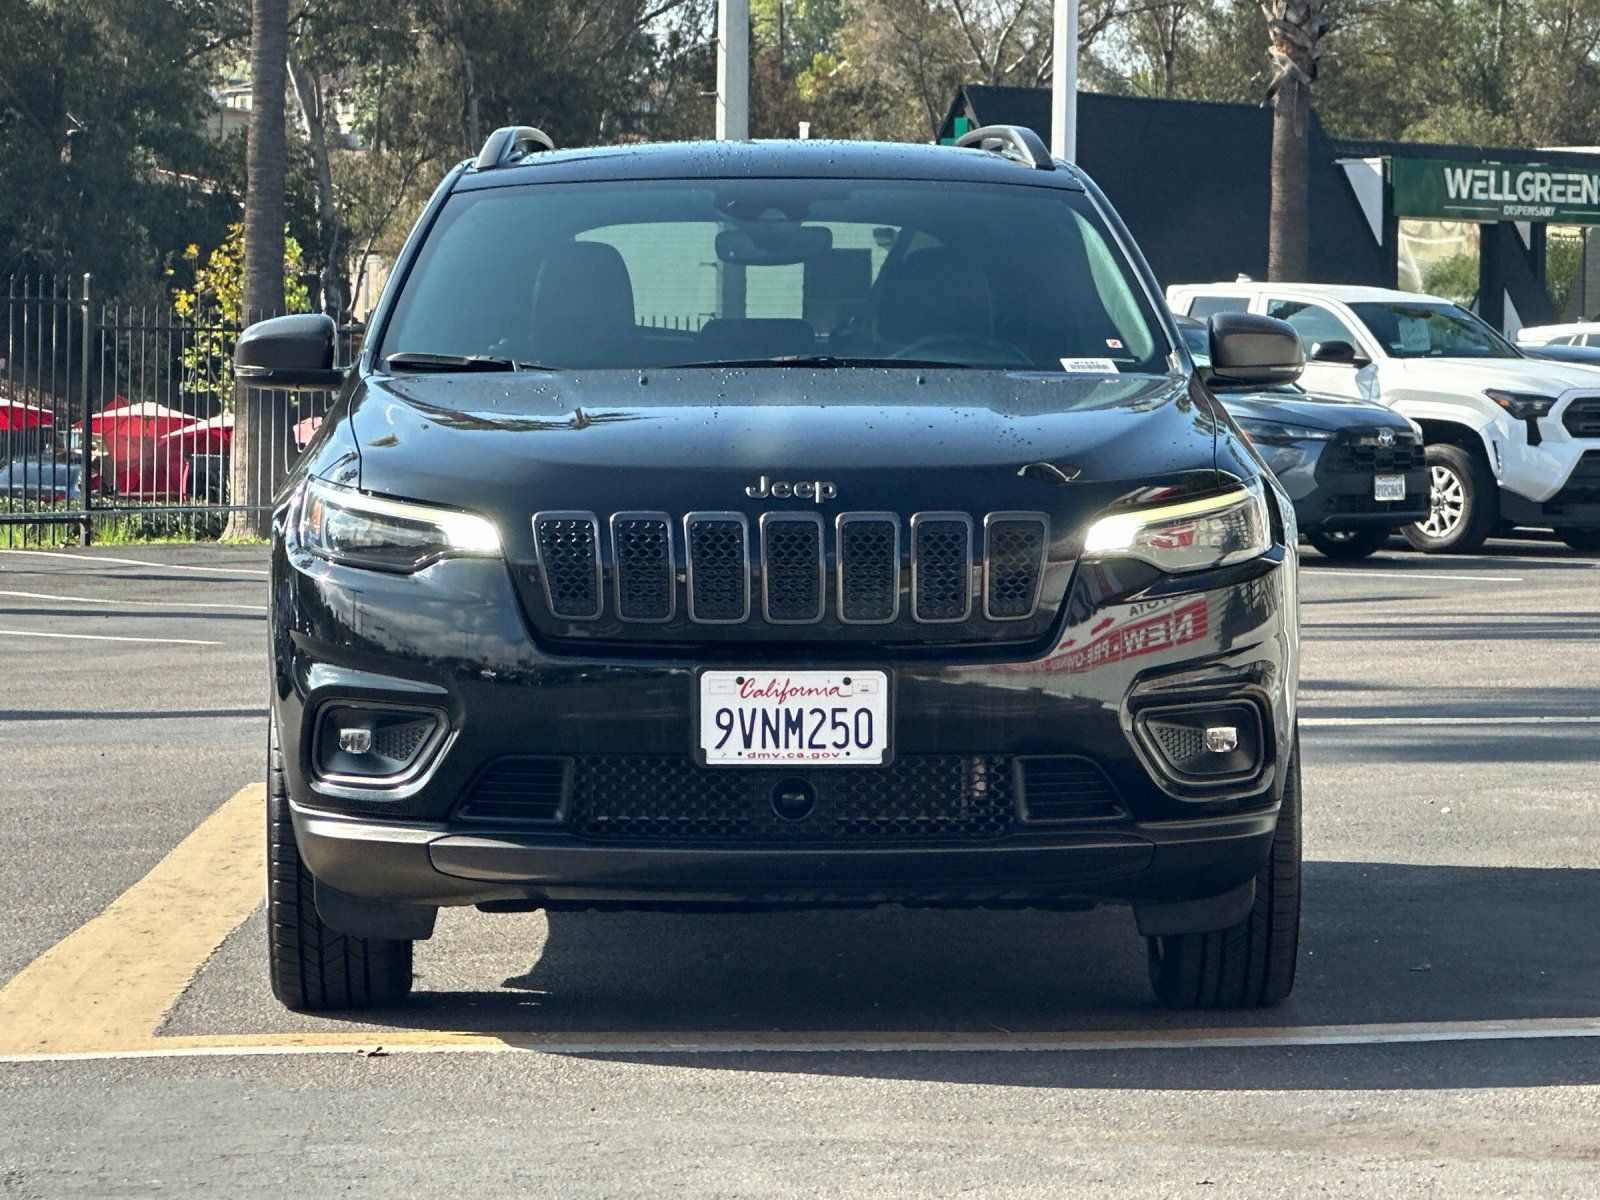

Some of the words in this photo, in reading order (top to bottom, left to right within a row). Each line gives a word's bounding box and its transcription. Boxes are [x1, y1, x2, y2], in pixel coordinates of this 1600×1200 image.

[1443, 167, 1600, 205] WELLGREEN
[1503, 205, 1556, 217] DISPENSARY
[745, 475, 837, 504] Jeep
[739, 677, 853, 705] California
[714, 707, 873, 750] 9VNM250
[747, 751, 841, 760] dmv.ca.gov
